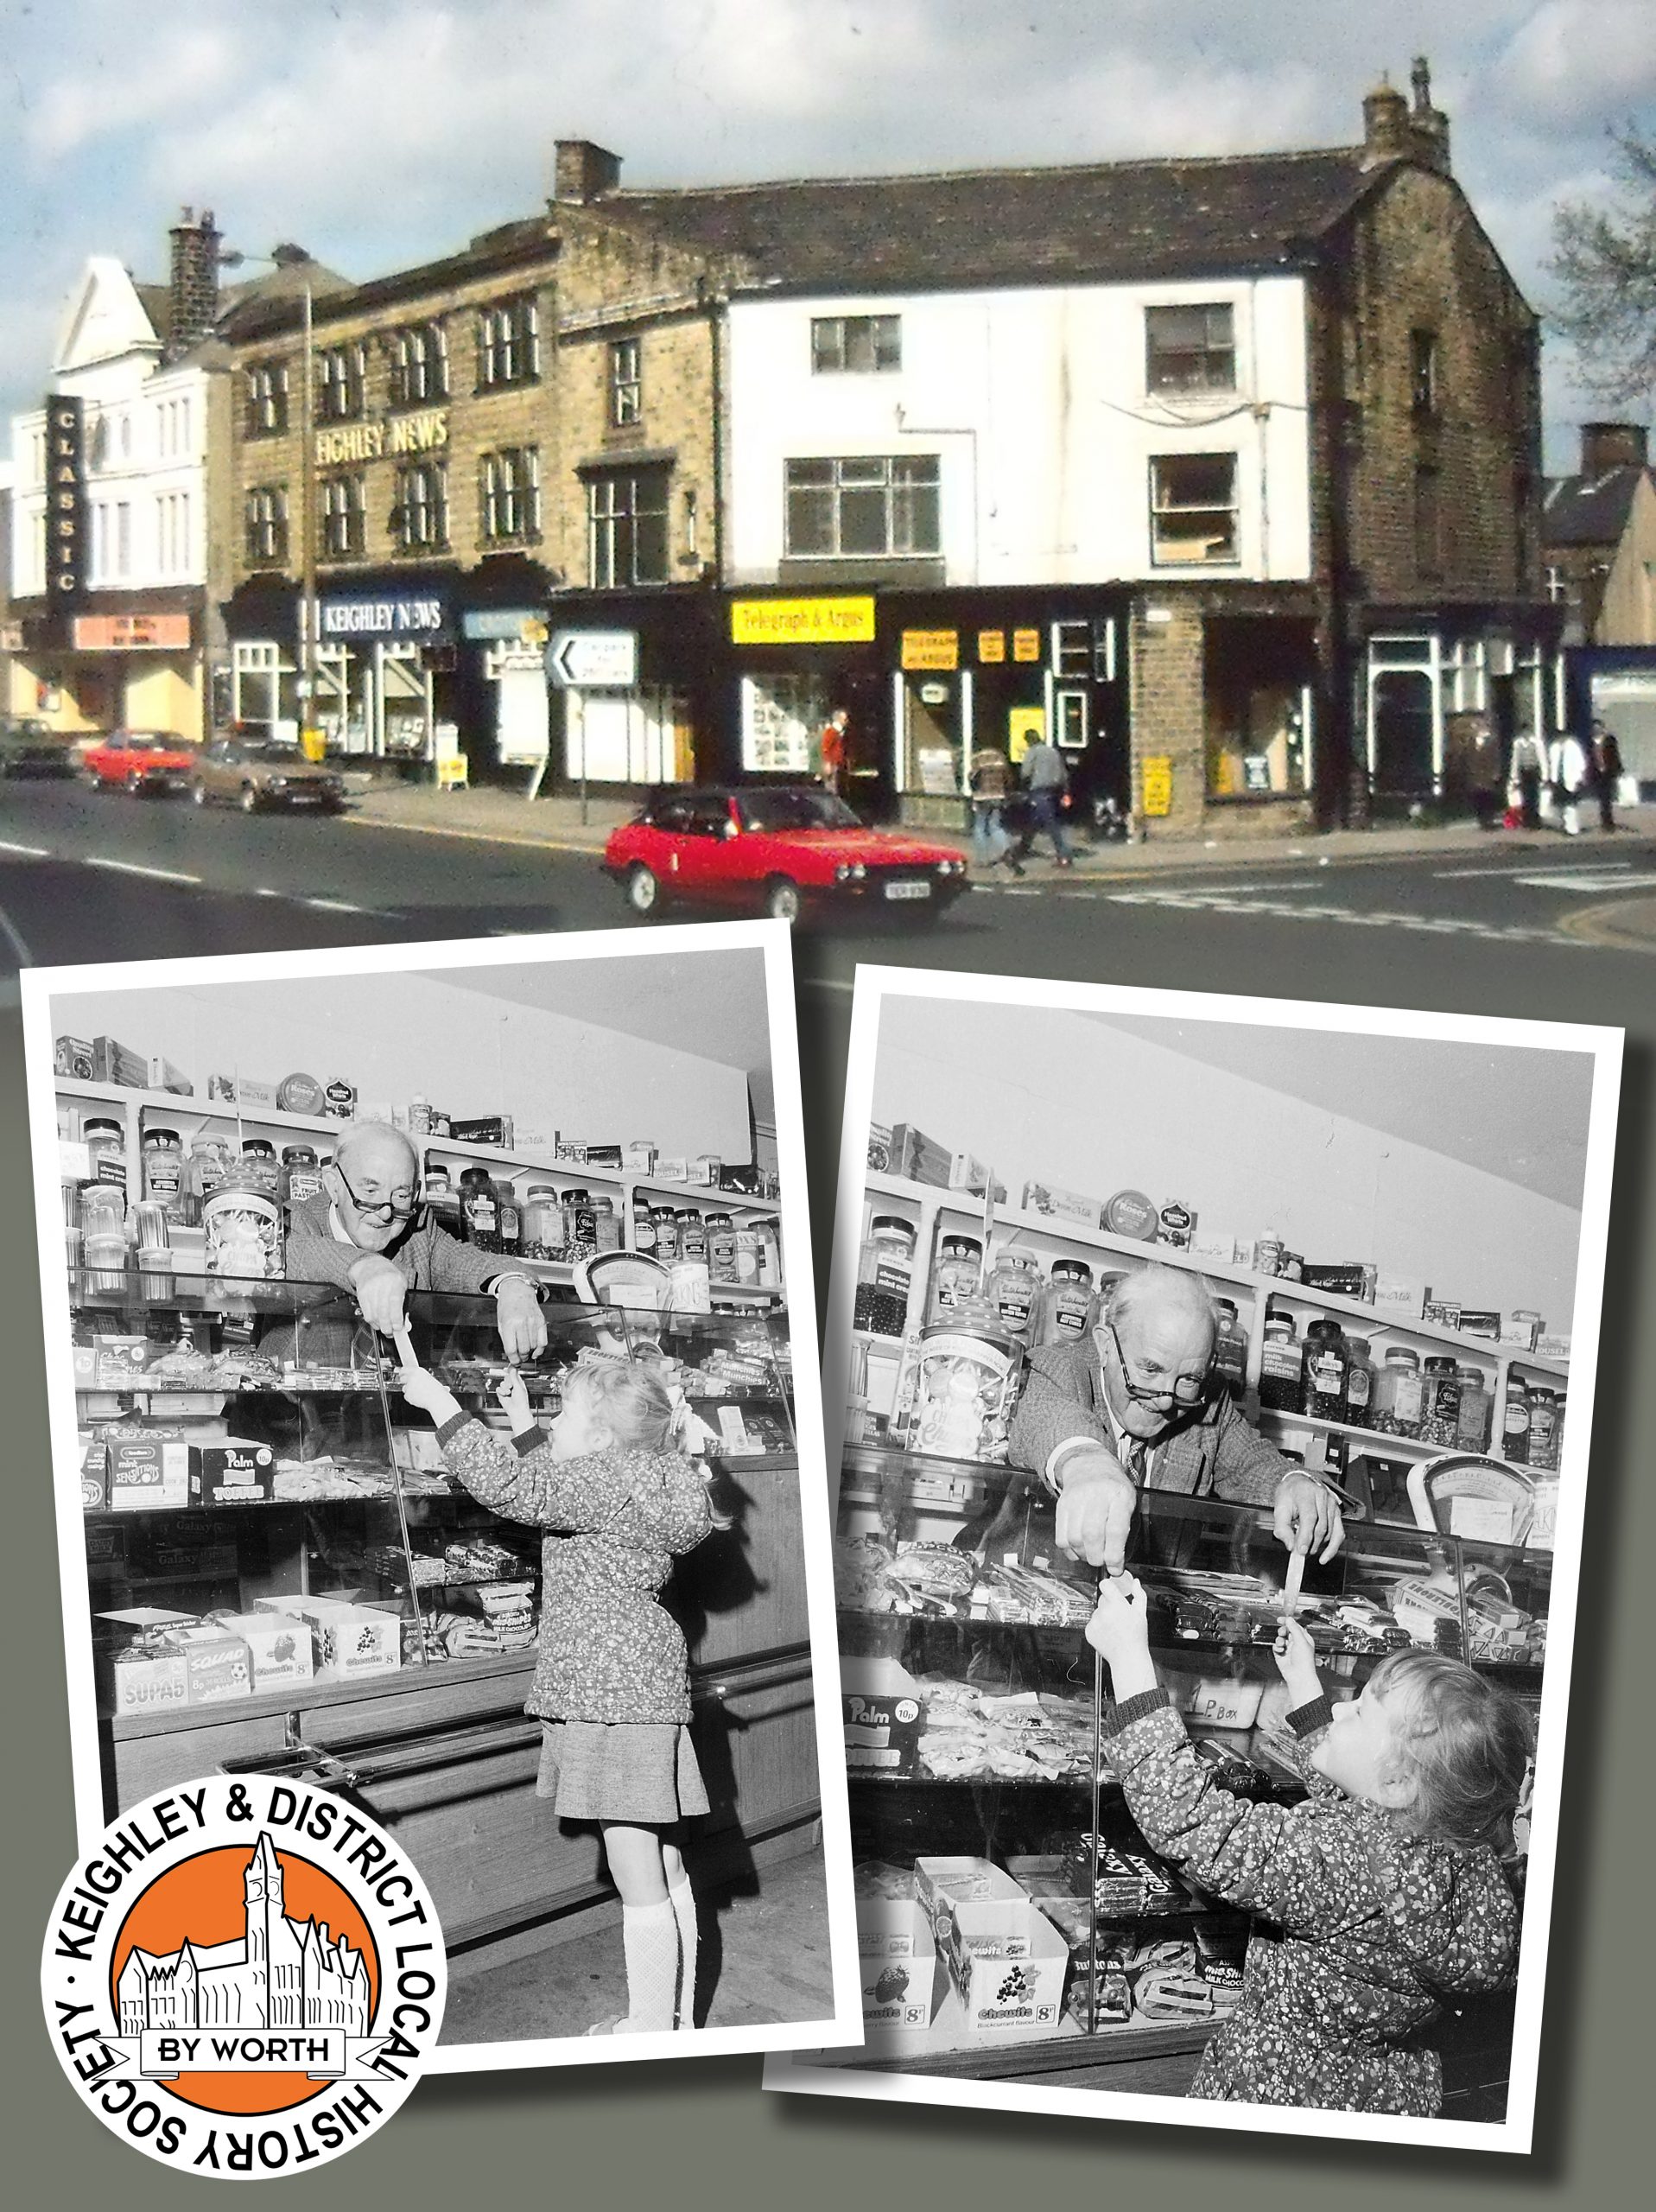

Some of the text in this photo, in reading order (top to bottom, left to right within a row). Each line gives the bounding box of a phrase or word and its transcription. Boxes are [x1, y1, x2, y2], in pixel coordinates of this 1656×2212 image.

[316, 413, 447, 464] EIGHLEY NEWS
[59, 412, 75, 591] CLASSIC
[326, 601, 441, 632] KEIGHLEY NEWS
[744, 608, 864, 632] Telegraph & Argus
[1119, 1202, 1148, 1219] Roses
[878, 1279, 896, 1289] mint
[721, 1361, 761, 1376] Munchies
[1264, 1366, 1294, 1377] raisins
[722, 1370, 763, 1385] Munchies
[118, 1459, 138, 1469] mint
[225, 1449, 254, 1469] Palm
[116, 1464, 160, 1484] SENSATIONS
[213, 1485, 264, 1501] TOFFEE
[176, 1520, 213, 1534] Galaxy
[158, 1555, 197, 1566] Galaxy
[190, 1649, 245, 1672] SQUAD
[346, 1654, 383, 1666] Chewits
[193, 1680, 205, 1691] 8p
[848, 1696, 890, 1724] Palm
[898, 1709, 914, 1719] 10p
[1126, 1853, 1168, 1892] Galaxy
[969, 1945, 1002, 1955] ewits
[1205, 1974, 1244, 1986] MILK CHOCO
[863, 2006, 901, 2020] ewits
[977, 2005, 1033, 2020] Chewits
[977, 2018, 1035, 2029] Blackcurrant flavour
